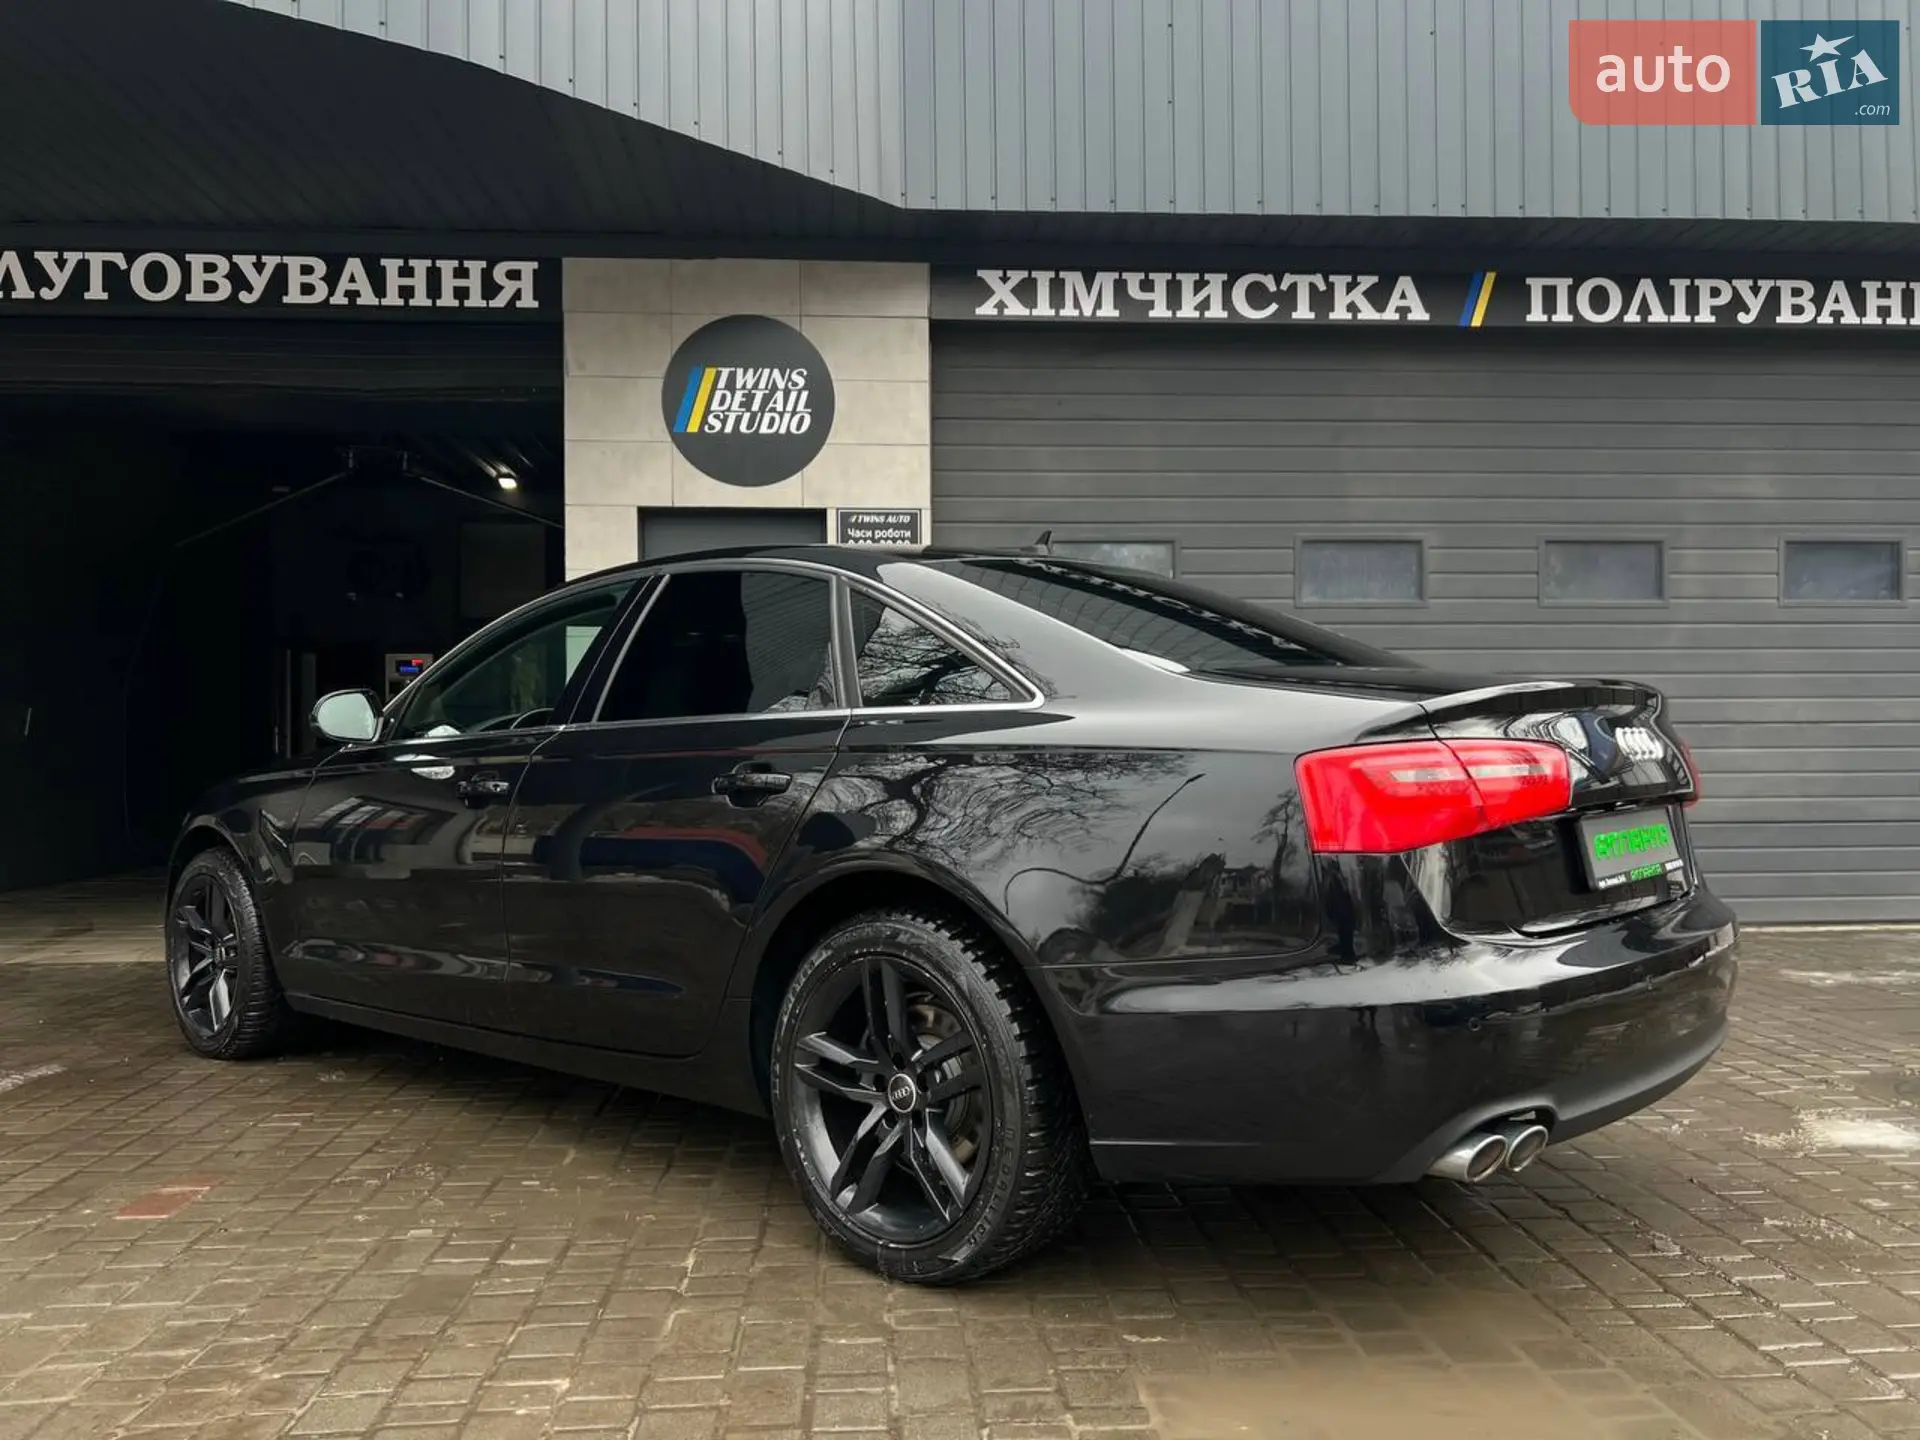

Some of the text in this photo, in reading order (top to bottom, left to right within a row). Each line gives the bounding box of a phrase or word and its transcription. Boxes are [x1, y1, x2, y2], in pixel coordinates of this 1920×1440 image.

[975, 269, 1920, 325] ХІМЧИСТКА ПОЛІРУВАН
[716, 367, 808, 390] TWINS
[710, 389, 812, 412] DETAIL
[704, 411, 812, 434] STUDIO
[886, 515, 911, 524] AUTO
[847, 527, 911, 540] Часи роботи
